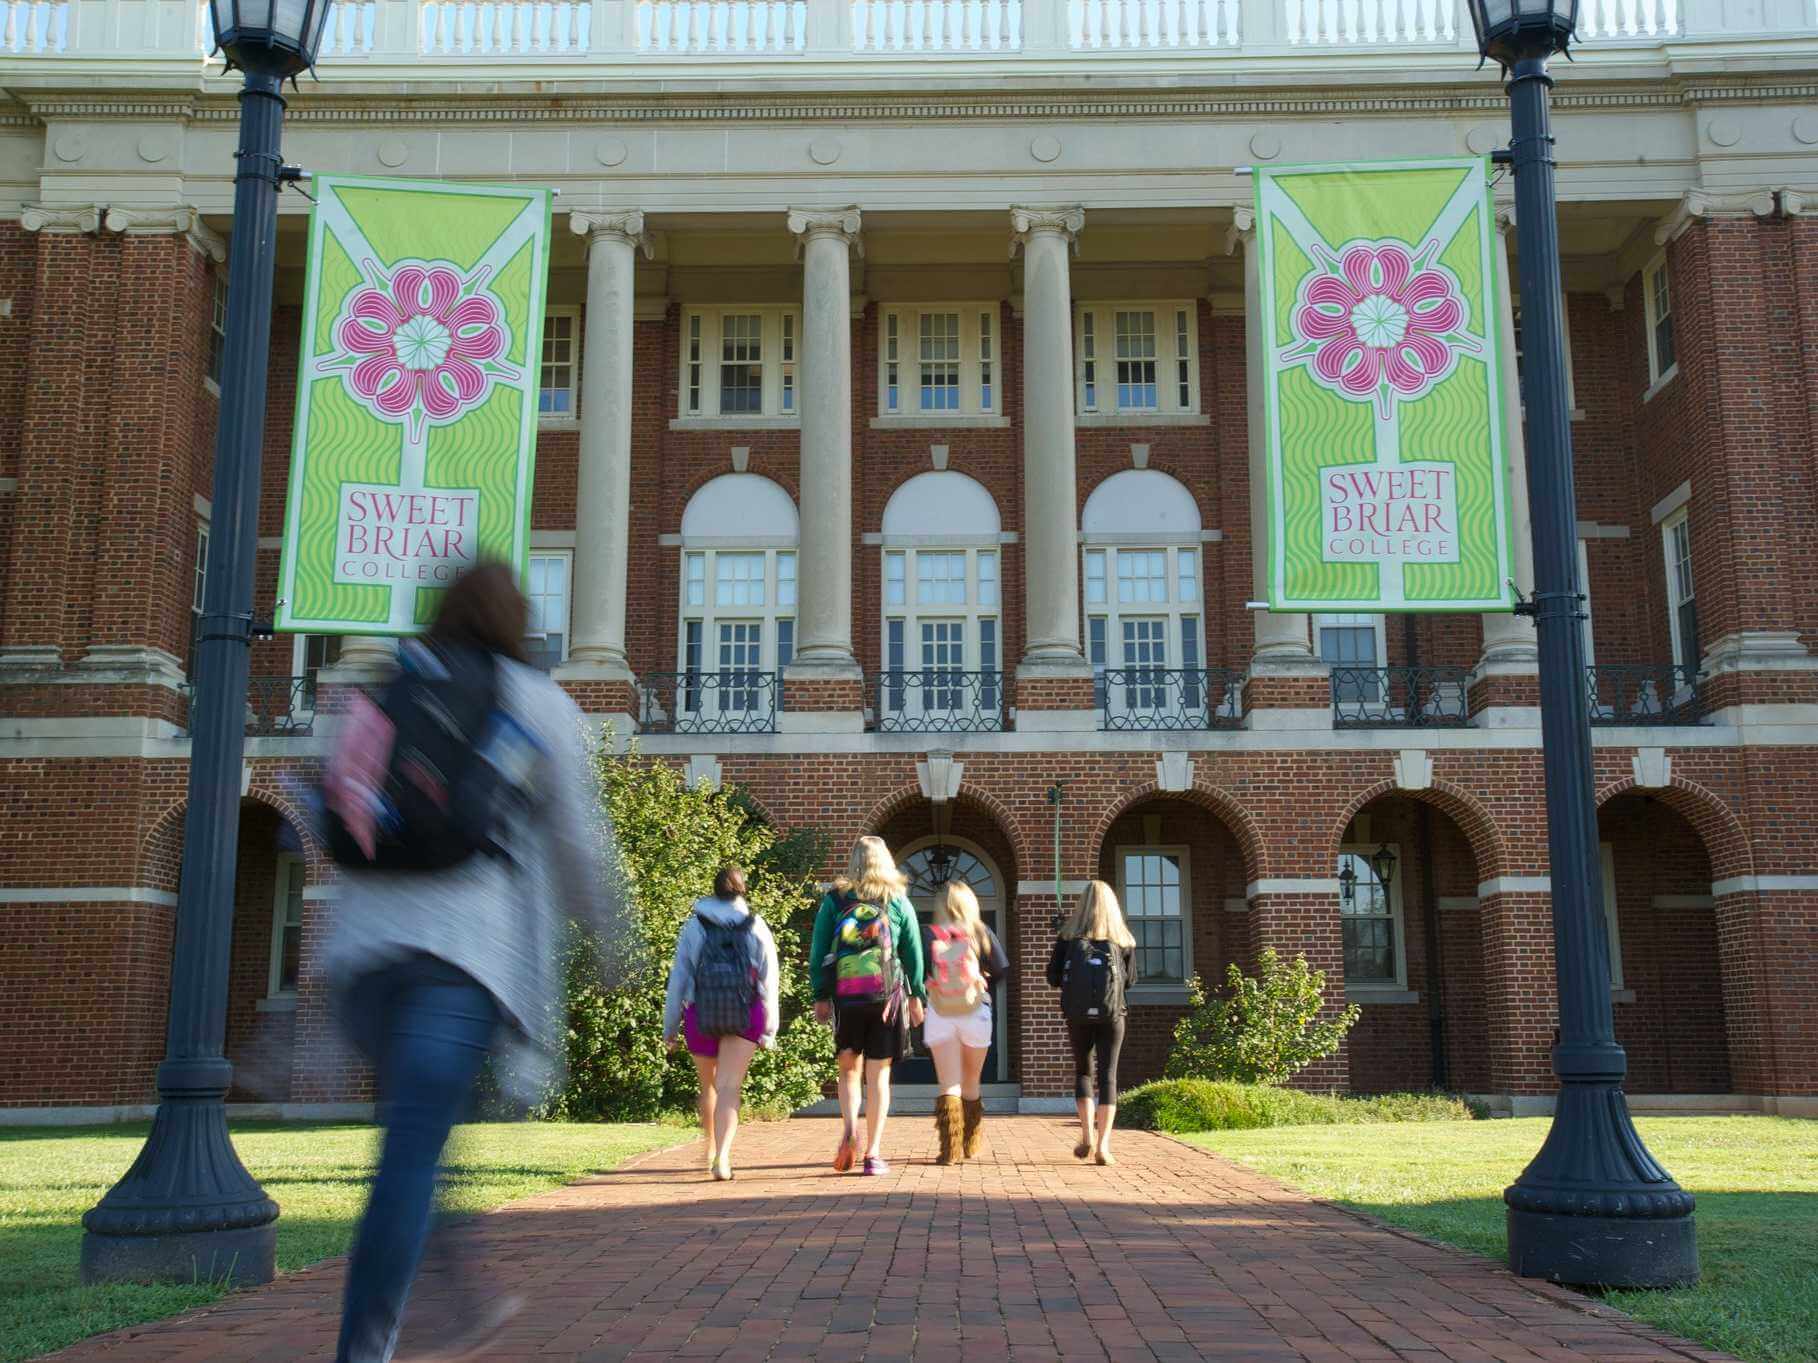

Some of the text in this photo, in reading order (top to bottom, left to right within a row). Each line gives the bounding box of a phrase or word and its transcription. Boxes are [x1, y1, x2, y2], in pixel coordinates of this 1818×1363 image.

[1329, 469, 1449, 503] SWEET
[347, 491, 473, 527] SWEET
[1331, 502, 1451, 537] BRIAR
[346, 524, 470, 561] BRIAR
[1328, 538, 1450, 556] COLLEGE
